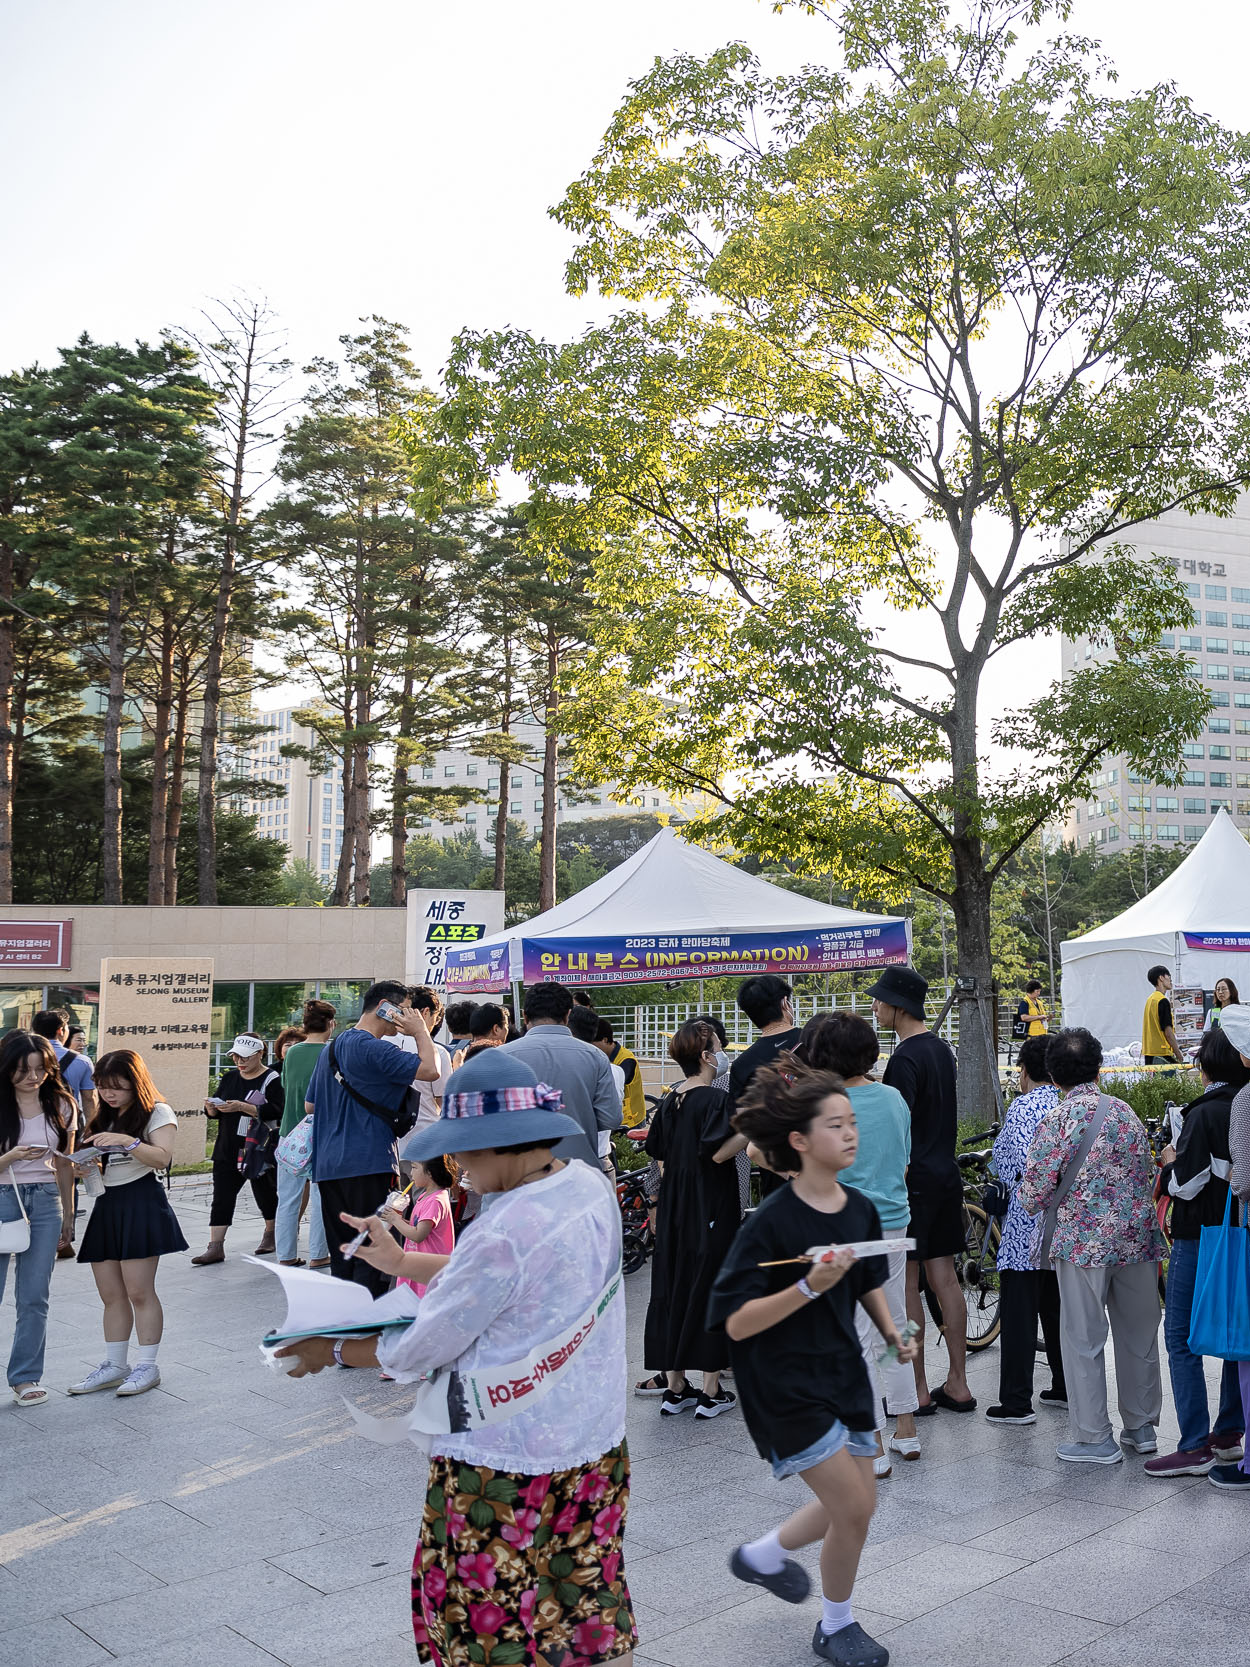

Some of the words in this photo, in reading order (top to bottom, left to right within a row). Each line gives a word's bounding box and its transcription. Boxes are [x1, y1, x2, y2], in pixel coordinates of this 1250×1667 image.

[426, 901, 466, 920] 세종
[430, 926, 479, 940] 스포츠
[626, 939, 655, 948] 2023
[658, 938, 679, 947] 군자
[681, 937, 730, 947] 한마당축제
[1203, 937, 1223, 945] 2023
[646, 945, 809, 968] (INFORMATION)
[822, 951, 839, 961] 안내
[109, 973, 211, 986] 세종뮤지엄갤러리
[173, 987, 209, 995] MUSEUM
[172, 996, 209, 1004] GALLERY
[106, 1025, 157, 1037] 세종대학교
[161, 1024, 209, 1035] 미래교육원
